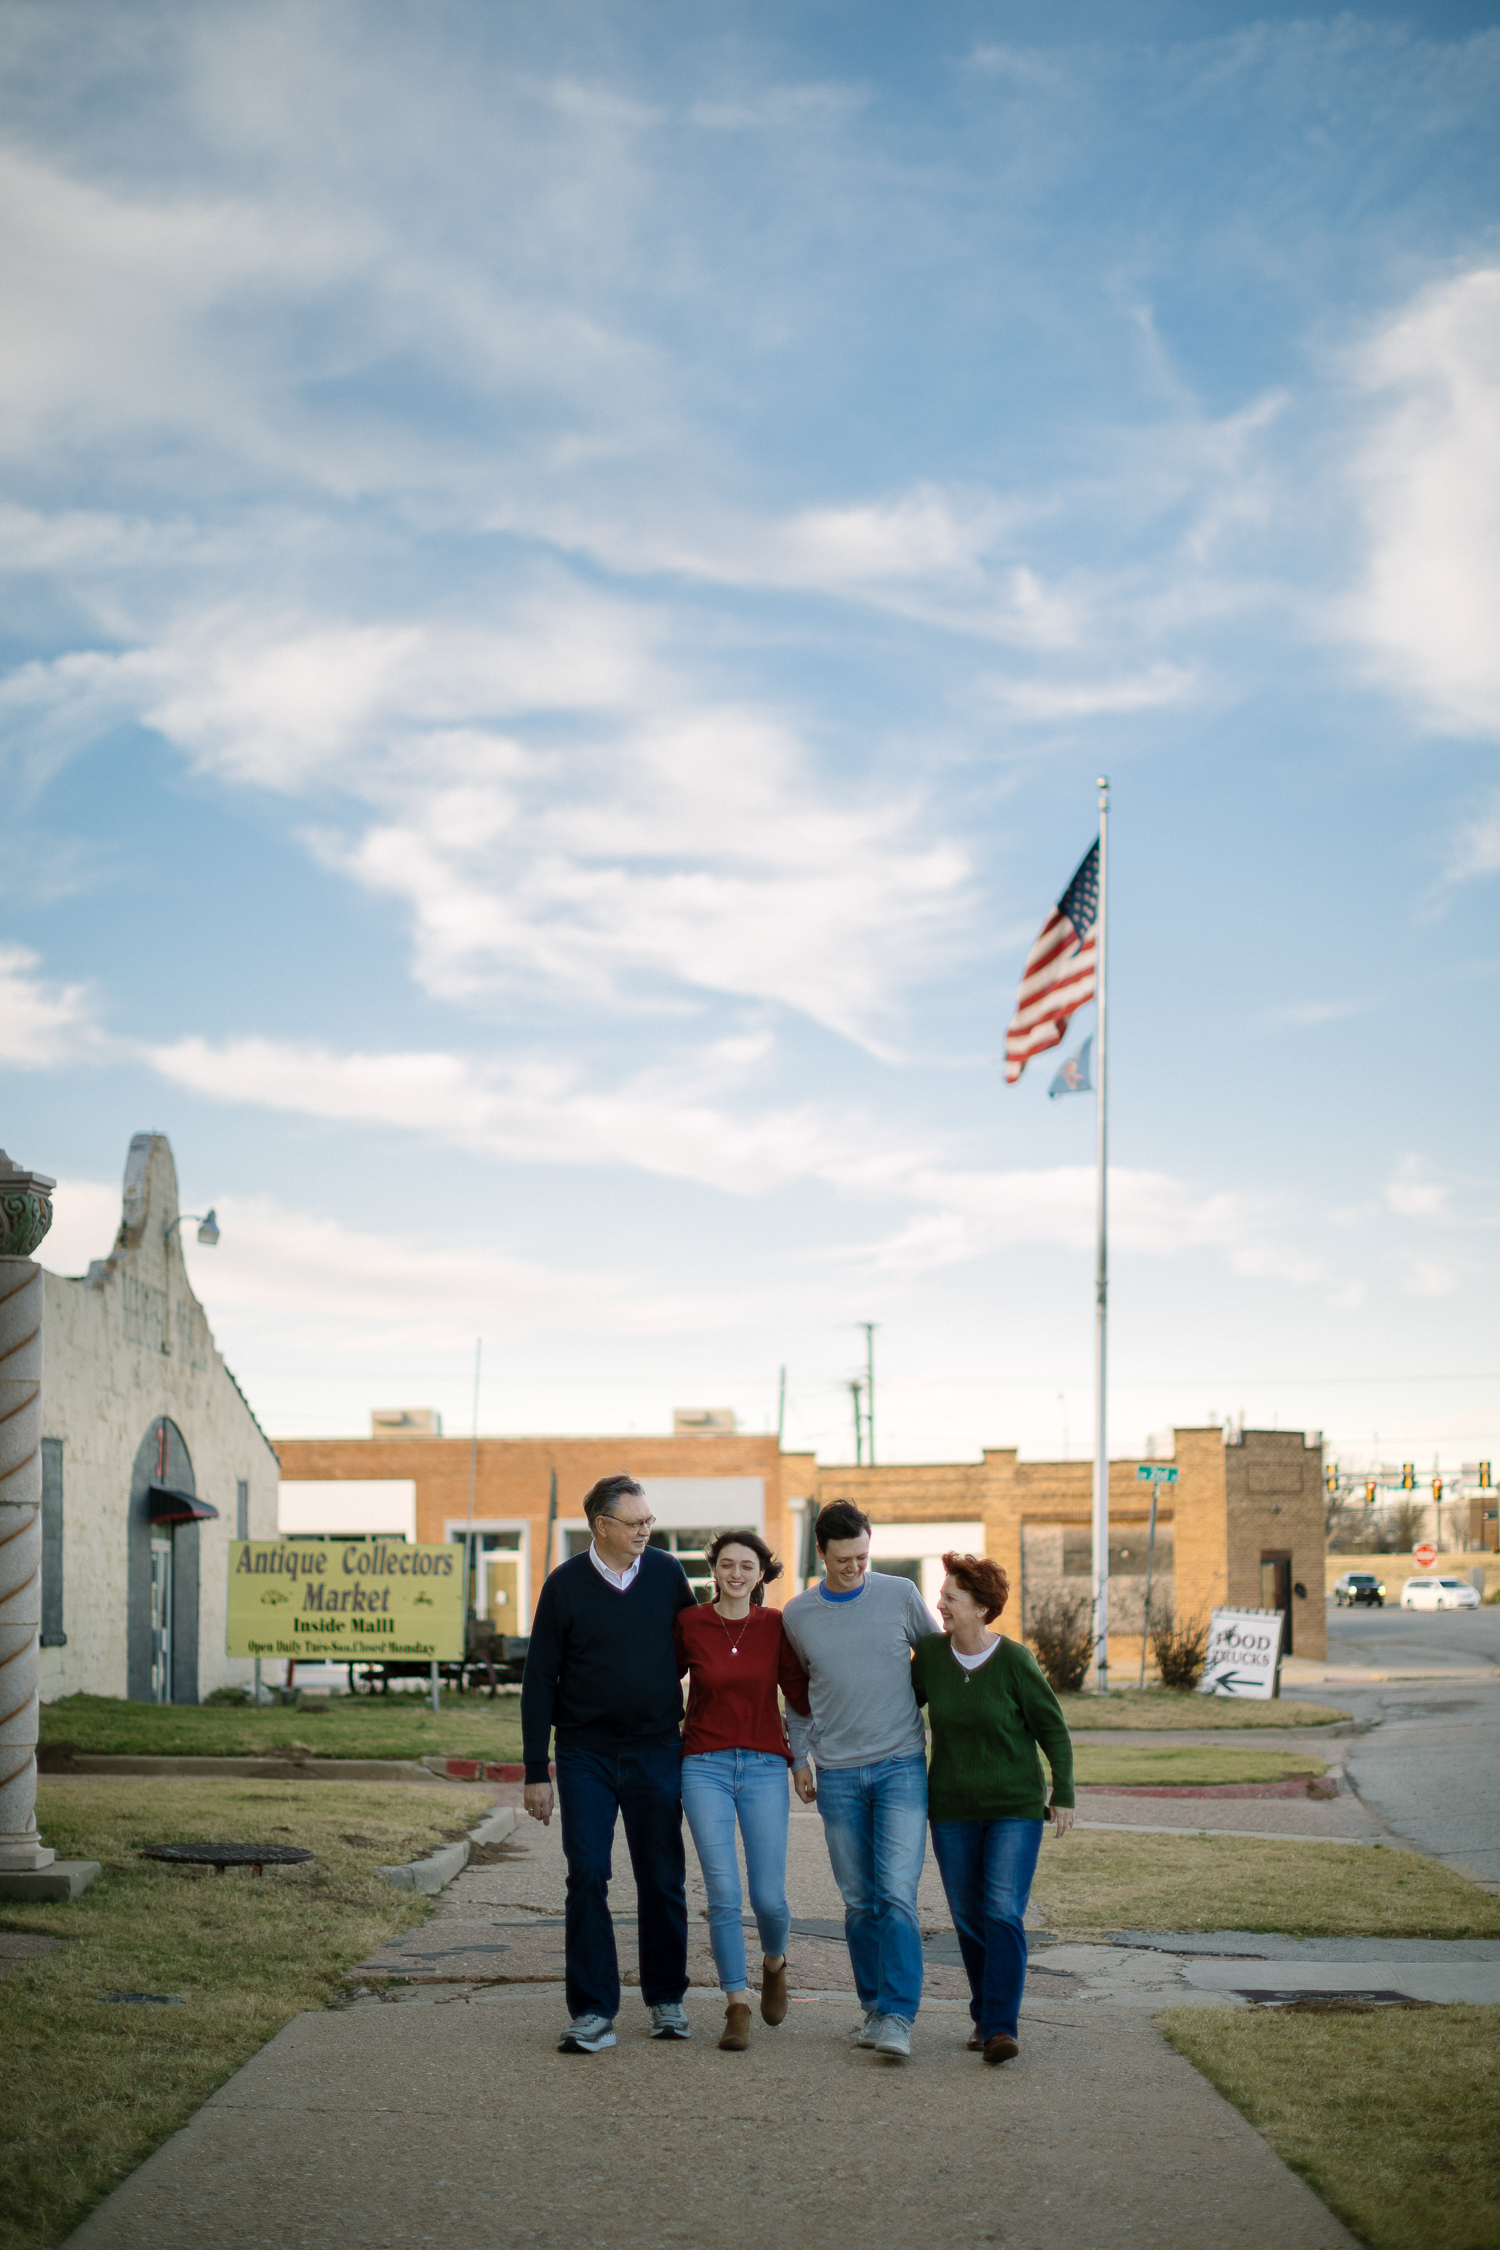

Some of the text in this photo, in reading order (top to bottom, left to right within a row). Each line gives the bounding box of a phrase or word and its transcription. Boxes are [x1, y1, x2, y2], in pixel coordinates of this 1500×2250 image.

[1150, 1466, 1168, 1480] 2nd
[236, 1544, 454, 1582] Antique Collectors
[302, 1581, 390, 1613] Market
[293, 1617, 345, 1633] Inside
[248, 1640, 273, 1654] Open
[276, 1640, 301, 1656] Daily
[388, 1640, 436, 1657] Monday
[1216, 1631, 1271, 1651] FOOD
[1213, 1650, 1270, 1668] TRUCKS
